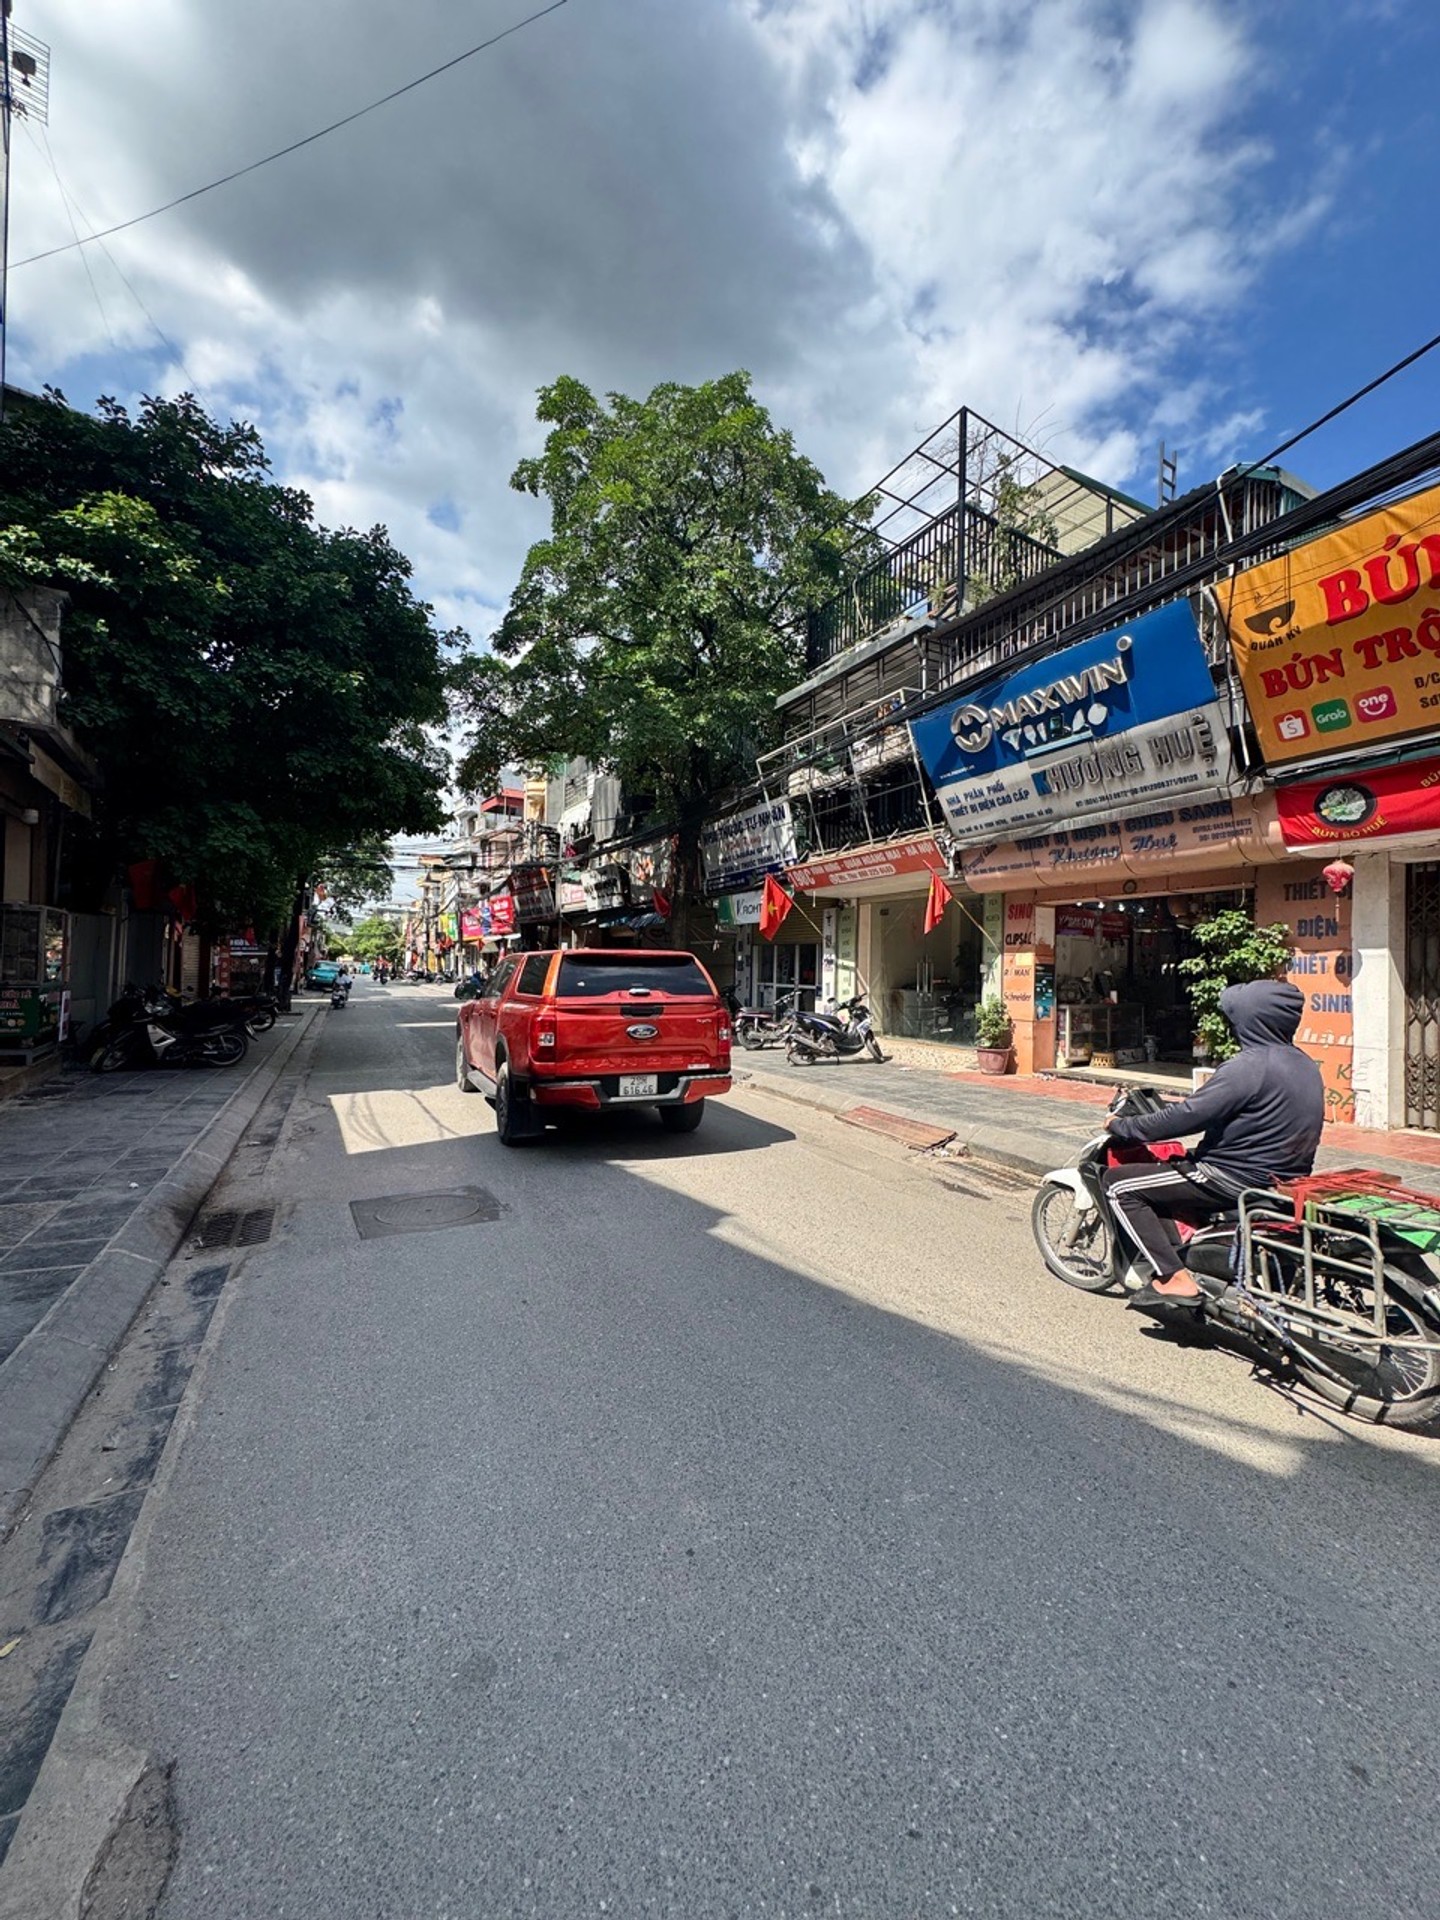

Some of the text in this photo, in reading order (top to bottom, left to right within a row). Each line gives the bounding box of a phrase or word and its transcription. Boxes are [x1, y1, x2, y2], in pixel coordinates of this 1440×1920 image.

[1318, 534, 1440, 626] BÚ
[989, 656, 1128, 731] MAXWIN
[1260, 648, 1345, 699] BÚN
[1315, 711, 1347, 727] Grab
[1031, 713, 1218, 797] KHƯƠNG HUỆ
[1007, 903, 1033, 920] SINO
[1297, 915, 1339, 939] ĐIỆN
